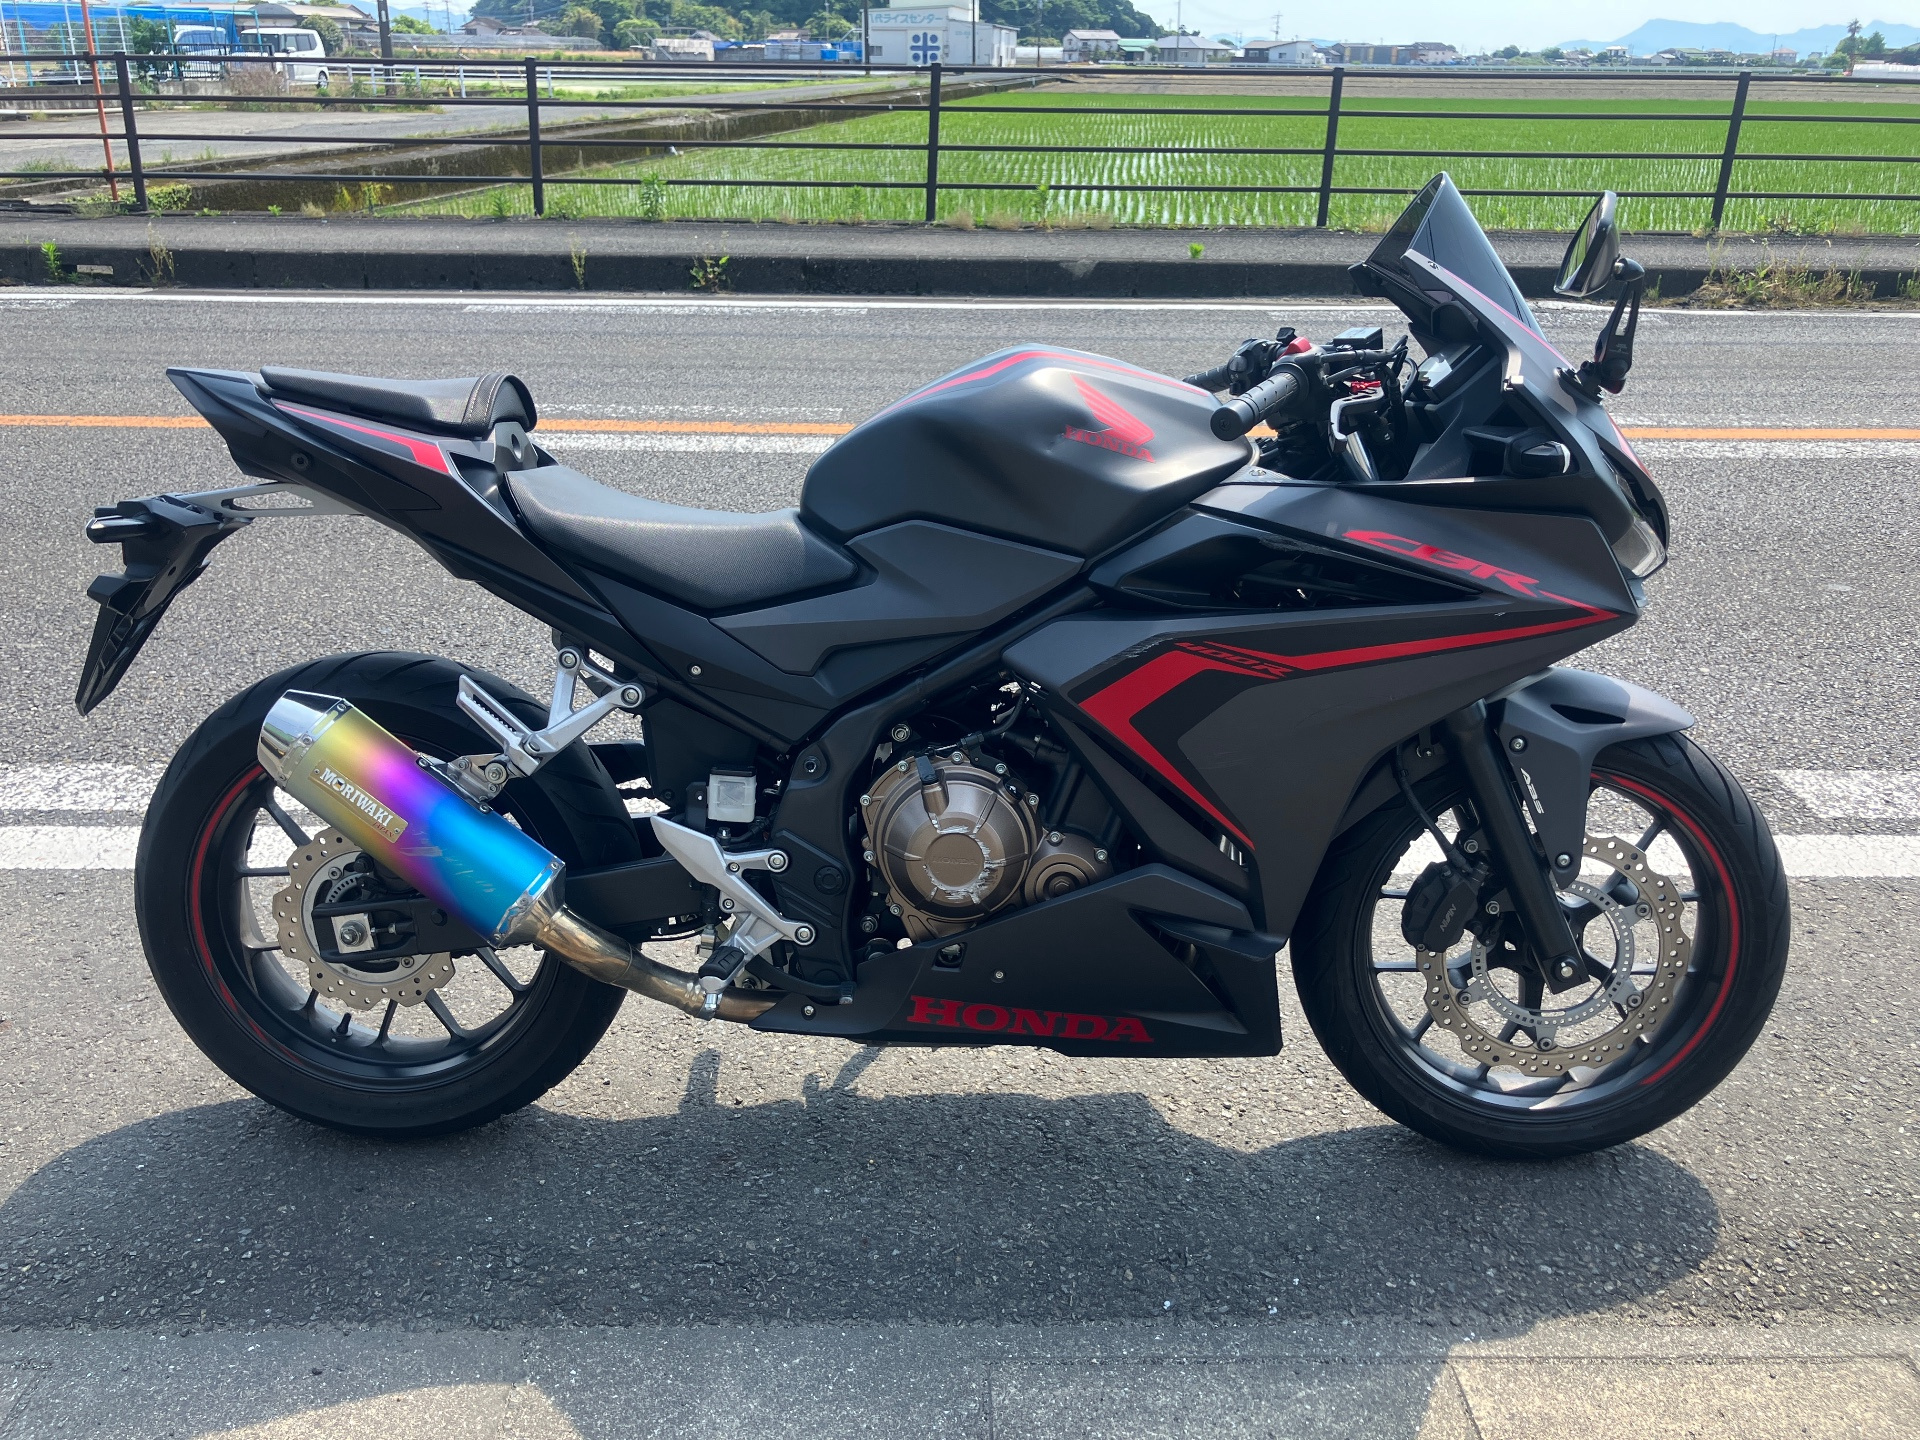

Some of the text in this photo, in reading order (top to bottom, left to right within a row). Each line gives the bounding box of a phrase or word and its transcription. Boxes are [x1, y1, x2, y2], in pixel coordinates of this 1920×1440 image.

[1064, 424, 1156, 463] HONDA
[1342, 530, 1540, 597] CBR
[1174, 641, 1294, 678] 400R
[319, 767, 394, 827] MORIWAKI
[1520, 767, 1545, 814] ABS
[372, 821, 395, 838] JAPAN
[931, 856, 979, 866] HONDA
[907, 995, 1155, 1043] HONDA
